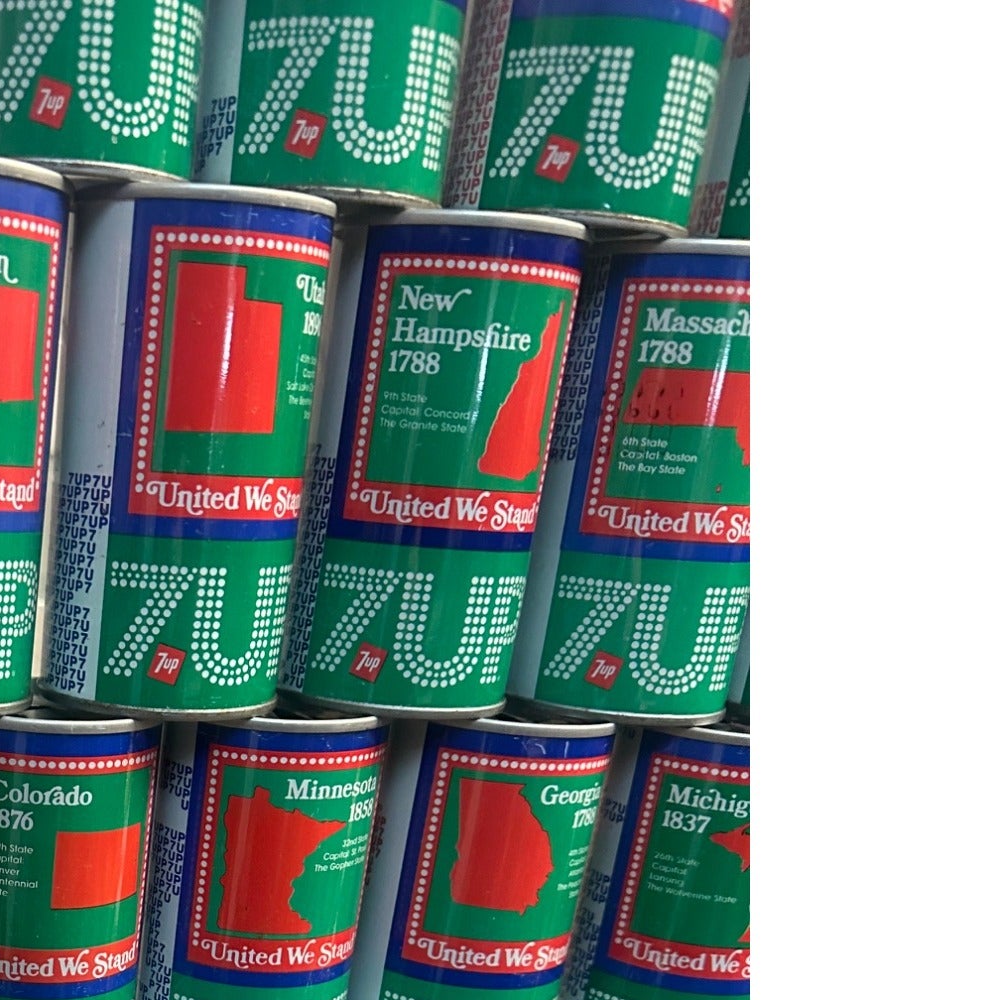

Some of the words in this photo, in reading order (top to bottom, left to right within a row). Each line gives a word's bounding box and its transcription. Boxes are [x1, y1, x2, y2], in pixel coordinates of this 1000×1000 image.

[36, 89, 65, 116] 7up
[291, 120, 320, 145] 7up
[541, 144, 571, 171] 7up
[398, 284, 472, 313] New
[391, 318, 531, 352] Hampshire
[388, 350, 441, 375] 1788
[638, 340, 694, 365] 1788
[383, 391, 399, 403] 9th
[401, 393, 428, 404] State
[380, 418, 397, 429] The
[399, 419, 439, 432] Granite
[440, 422, 467, 434] State
[424, 408, 471, 421] Concord
[622, 437, 638, 448] 6th
[640, 438, 668, 449] State
[618, 461, 635, 472] The
[637, 462, 658, 476] Bay
[659, 463, 686, 476] State
[663, 451, 698, 463] Boston
[146, 480, 240, 515] United
[243, 478, 275, 511] We
[360, 489, 450, 523] United
[455, 491, 491, 522] We
[490, 499, 536, 532] Stand
[598, 505, 688, 537] United
[693, 506, 728, 536] We
[311, 562, 527, 688] 7UP
[157, 652, 180, 673] 7up
[355, 651, 381, 672] 7up
[591, 659, 616, 679] 7up
[285, 774, 376, 800] Minnesota
[348, 800, 374, 823] 1858
[667, 783, 750, 819] Michig
[661, 810, 712, 835] 1837
[9, 843, 34, 855] State
[648, 881, 664, 893] The
[714, 894, 738, 905] State
[58, 949, 90, 976] We
[91, 942, 136, 979] Stand
[201, 939, 282, 970] United
[287, 940, 316, 966] We
[417, 937, 500, 969] United
[505, 942, 536, 967] We
[623, 937, 706, 971] United
[706, 950, 742, 974] We
